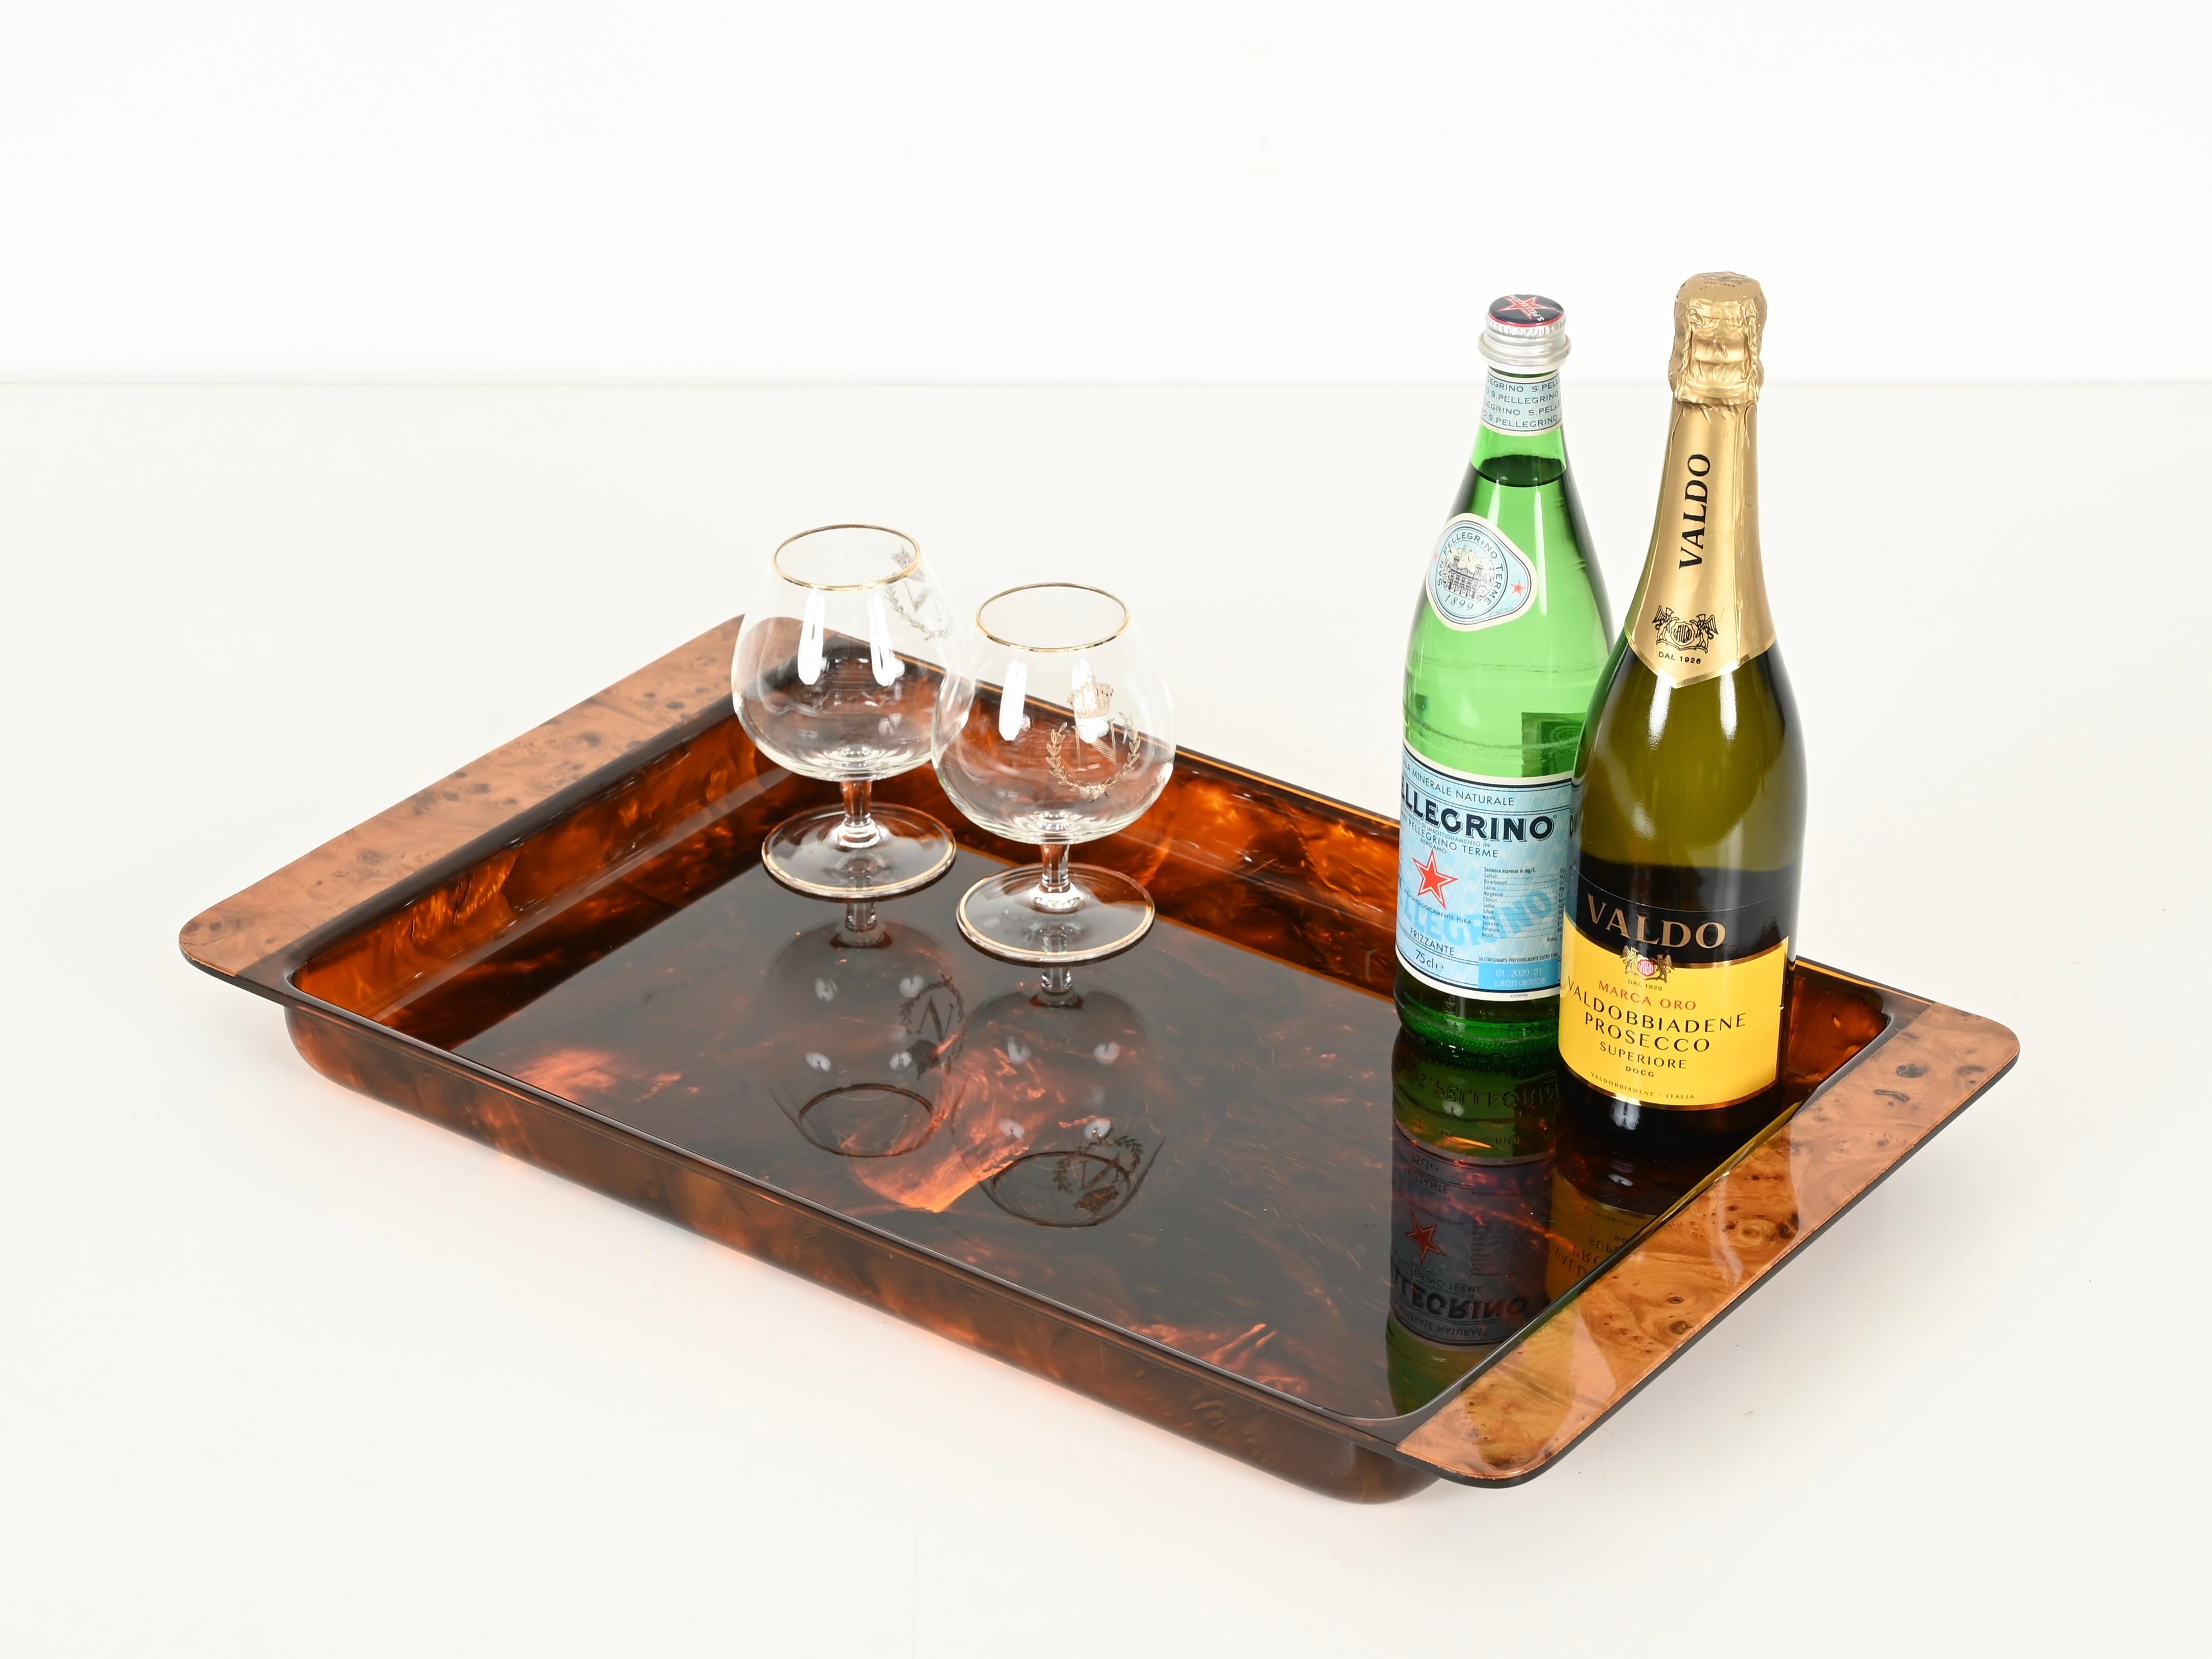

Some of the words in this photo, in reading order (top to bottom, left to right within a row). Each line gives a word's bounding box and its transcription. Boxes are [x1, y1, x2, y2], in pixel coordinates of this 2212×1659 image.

[1491, 390, 1558, 404] S.PELLEGRINO
[1488, 414, 1558, 428] S.PELLEGRINO
[1679, 454, 1710, 569] VALDO
[1443, 532, 1497, 559] PELLEGRINO
[1484, 563, 1504, 605] TERME
[1444, 594, 1474, 611] 1899
[1658, 651, 1675, 661] DAL
[1680, 656, 1701, 664] 1926
[1412, 769, 1451, 796] MINERALE
[1456, 790, 1514, 806] NATURALE
[1409, 820, 1457, 851] PELLEGRINO
[1462, 845, 1498, 858] TERME
[1420, 838, 1446, 854] BERGAMO
[1587, 893, 1726, 949] VALDO
[1410, 927, 1455, 956] FRIZZANTE
[1568, 976, 1746, 1033] VALDOBBIADENE
[1599, 980, 1651, 1006] MARCA
[1660, 998, 1696, 1011] ORO
[1585, 1012, 1710, 1052] PROSECCO
[1600, 1041, 1687, 1069] SUPERIORE
[1591, 1072, 1654, 1097] VALDOBBIADENE
[1625, 1066, 1654, 1077] DOCG
